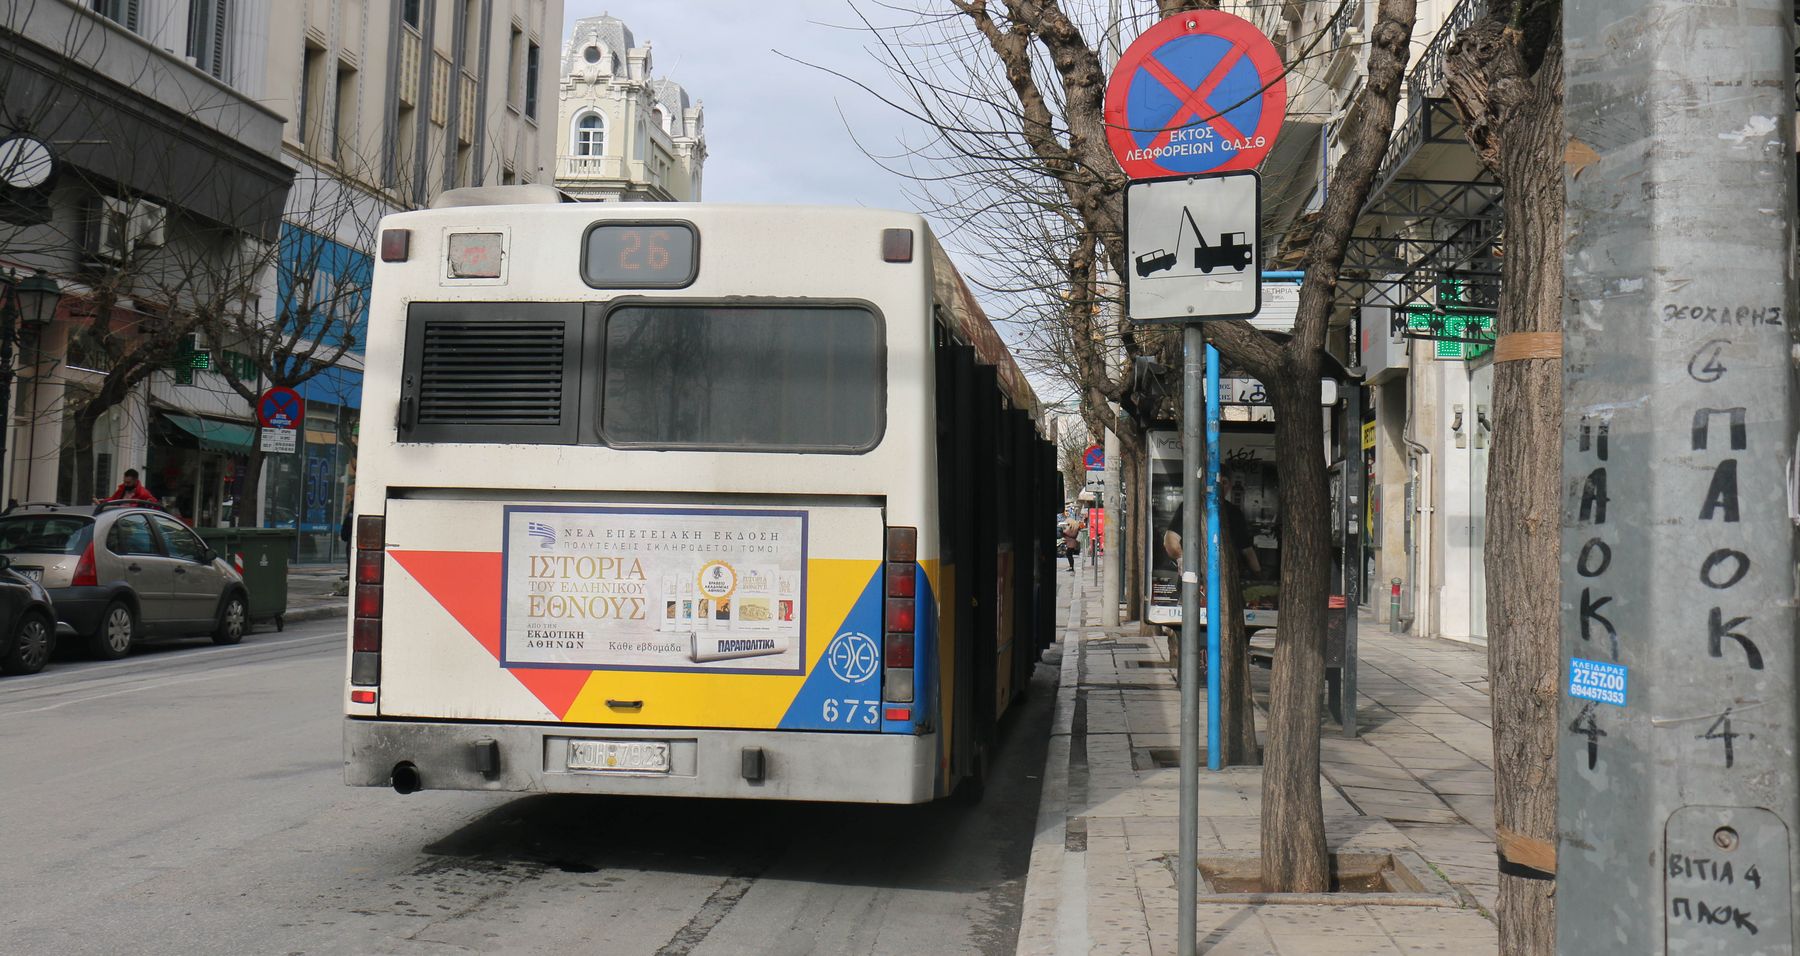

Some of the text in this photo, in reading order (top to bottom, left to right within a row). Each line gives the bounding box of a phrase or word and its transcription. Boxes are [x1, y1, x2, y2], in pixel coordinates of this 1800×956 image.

[1170, 127, 1214, 142] ΕΚΤΟΣ
[1126, 141, 1214, 161] ΛΕΩΦΟΡΕΙΩΝ
[619, 231, 670, 270] 26
[564, 529, 779, 541] ΝΕΑ ΕΠΕΤΕΙΑΚΗ ΕΚΔΟΣΗ
[564, 541, 779, 553] ΠΟΛΥΤΕΛΕΙΣ ΣΚΛΗΡΟΔΕΤΟΙ ΤΟΜΟΙ
[528, 555, 647, 581] ΙΣΤΟΡΙΑ
[528, 581, 645, 594] ΤΟΥ ΕΛΛΗΝΙΚΟΥ
[1692, 407, 1764, 769] ΠΑΟΚ 4
[527, 594, 646, 620] ΕΘΝΟΥΣ
[527, 630, 584, 639] ΕΚΔΟΤΙΚΗ
[527, 641, 584, 649] ΑΘΗΝΩΝ
[609, 642, 681, 653] Κάθε εβδομάδα
[718, 639, 775, 652] ΠΑΡΑΠΟΛΙΤΙΚΑ
[1572, 660, 1625, 676] ΚΛΕΙΔΑΡΑΣ
[1573, 668, 1624, 691] 27.57.00
[1571, 683, 1624, 704] 6944575353
[823, 698, 879, 724] 673
[1744, 863, 1761, 890] 4
[1672, 897, 1759, 936] ΠΑΟΚ
